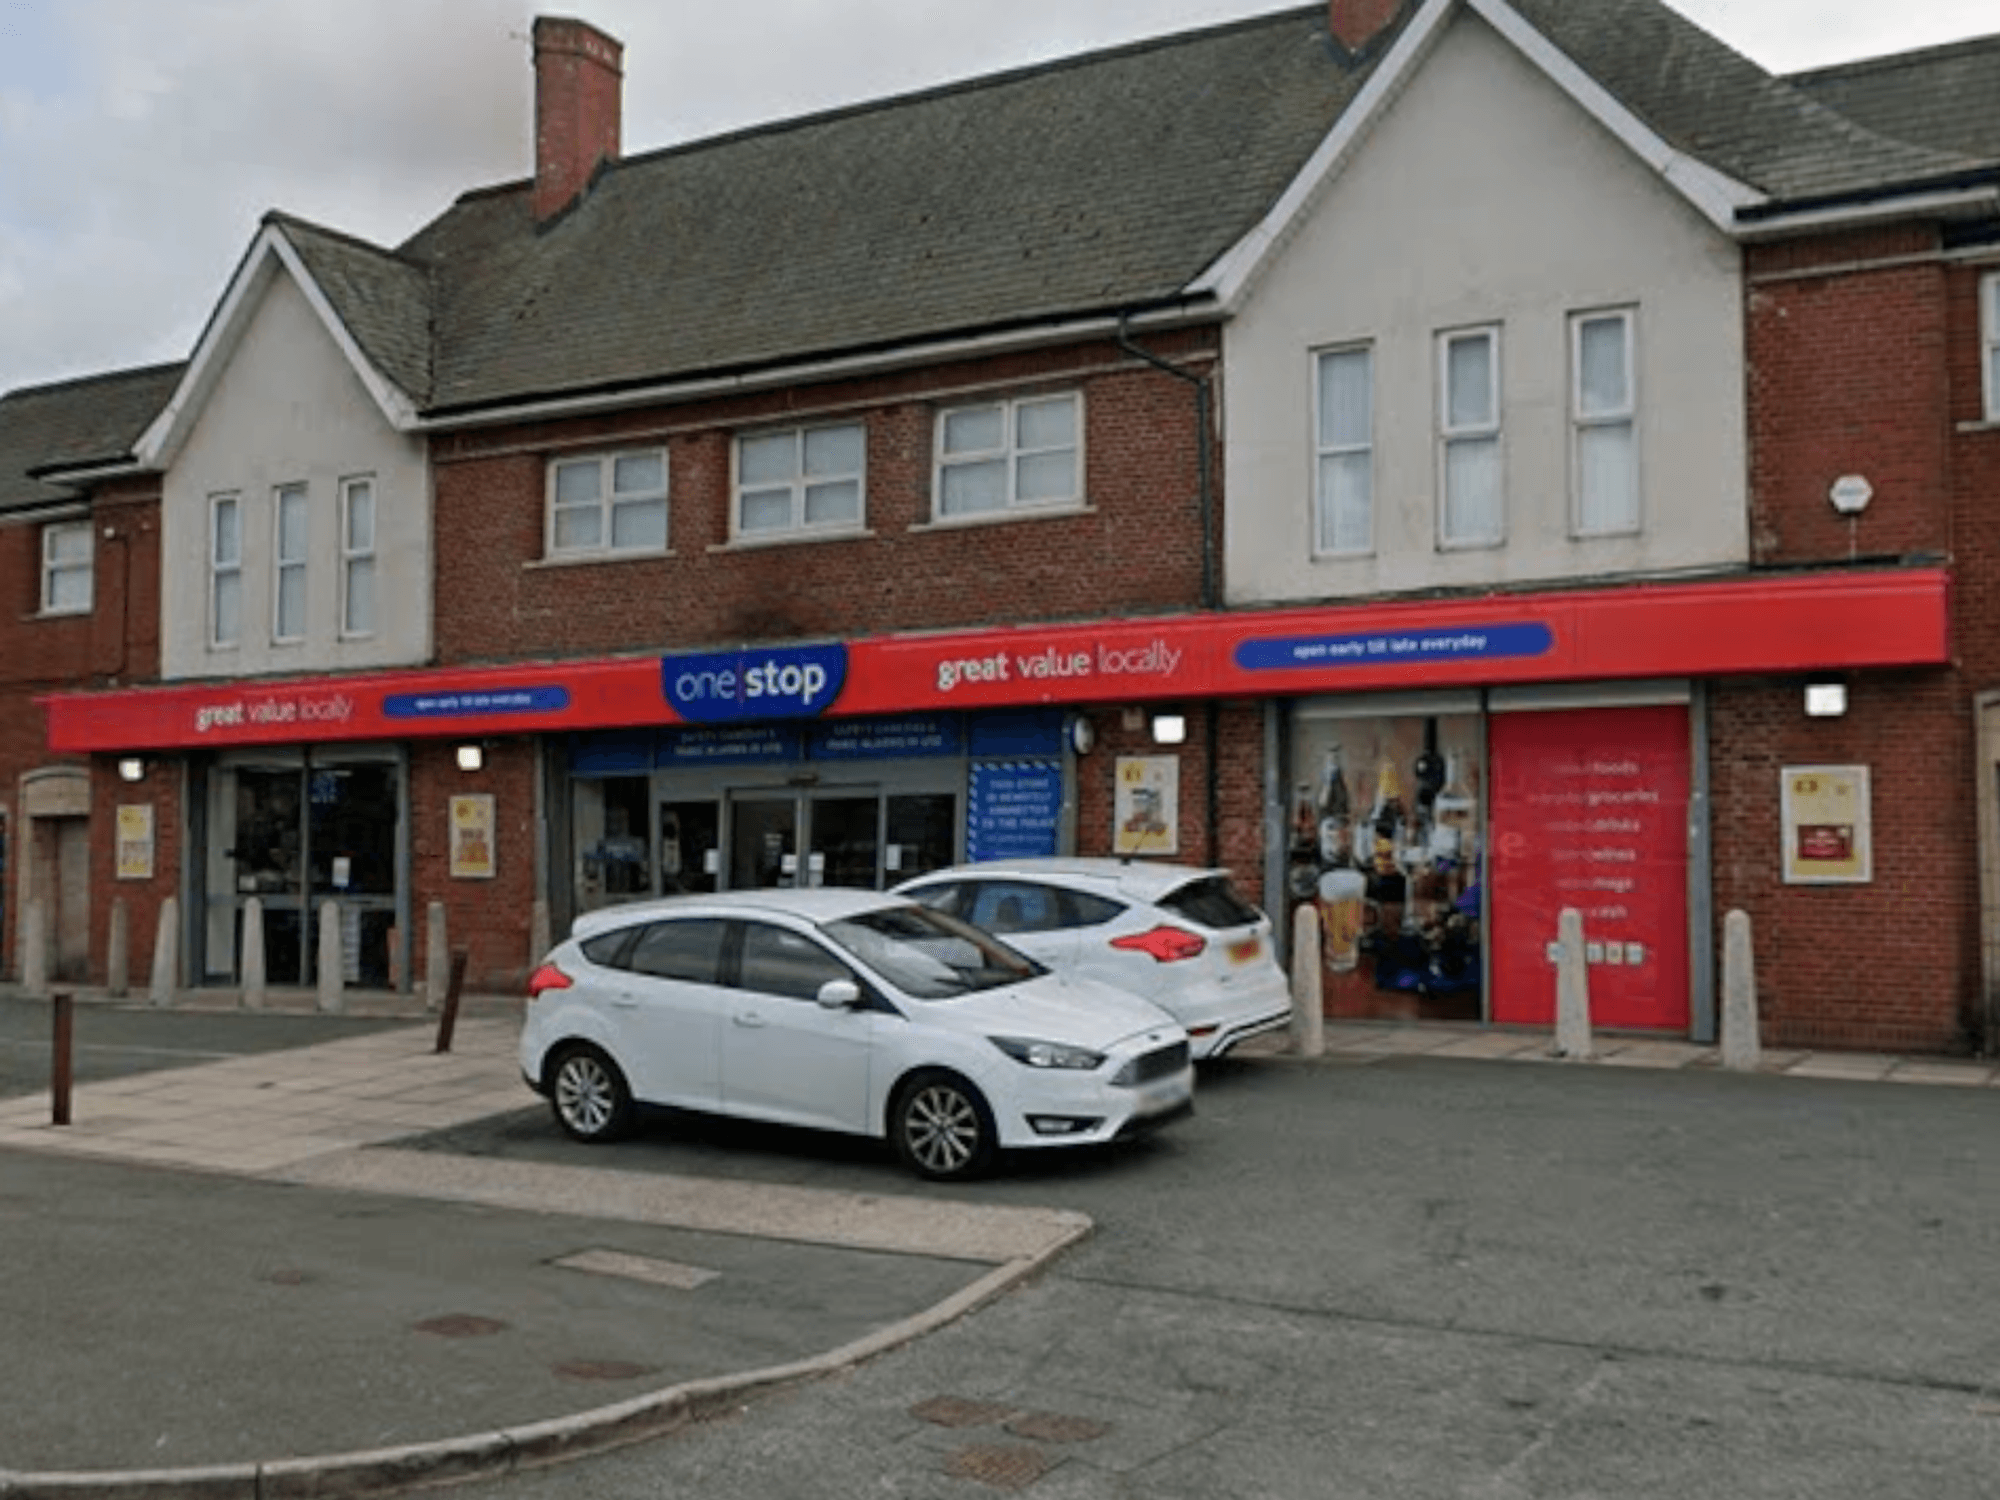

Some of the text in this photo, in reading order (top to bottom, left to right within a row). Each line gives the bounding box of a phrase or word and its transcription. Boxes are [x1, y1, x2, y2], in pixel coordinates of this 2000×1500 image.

[936, 638, 1182, 692] great value locally
[1292, 633, 1488, 660] open early till late everyday
[675, 658, 828, 706] one stop
[195, 693, 353, 732] great value locally
